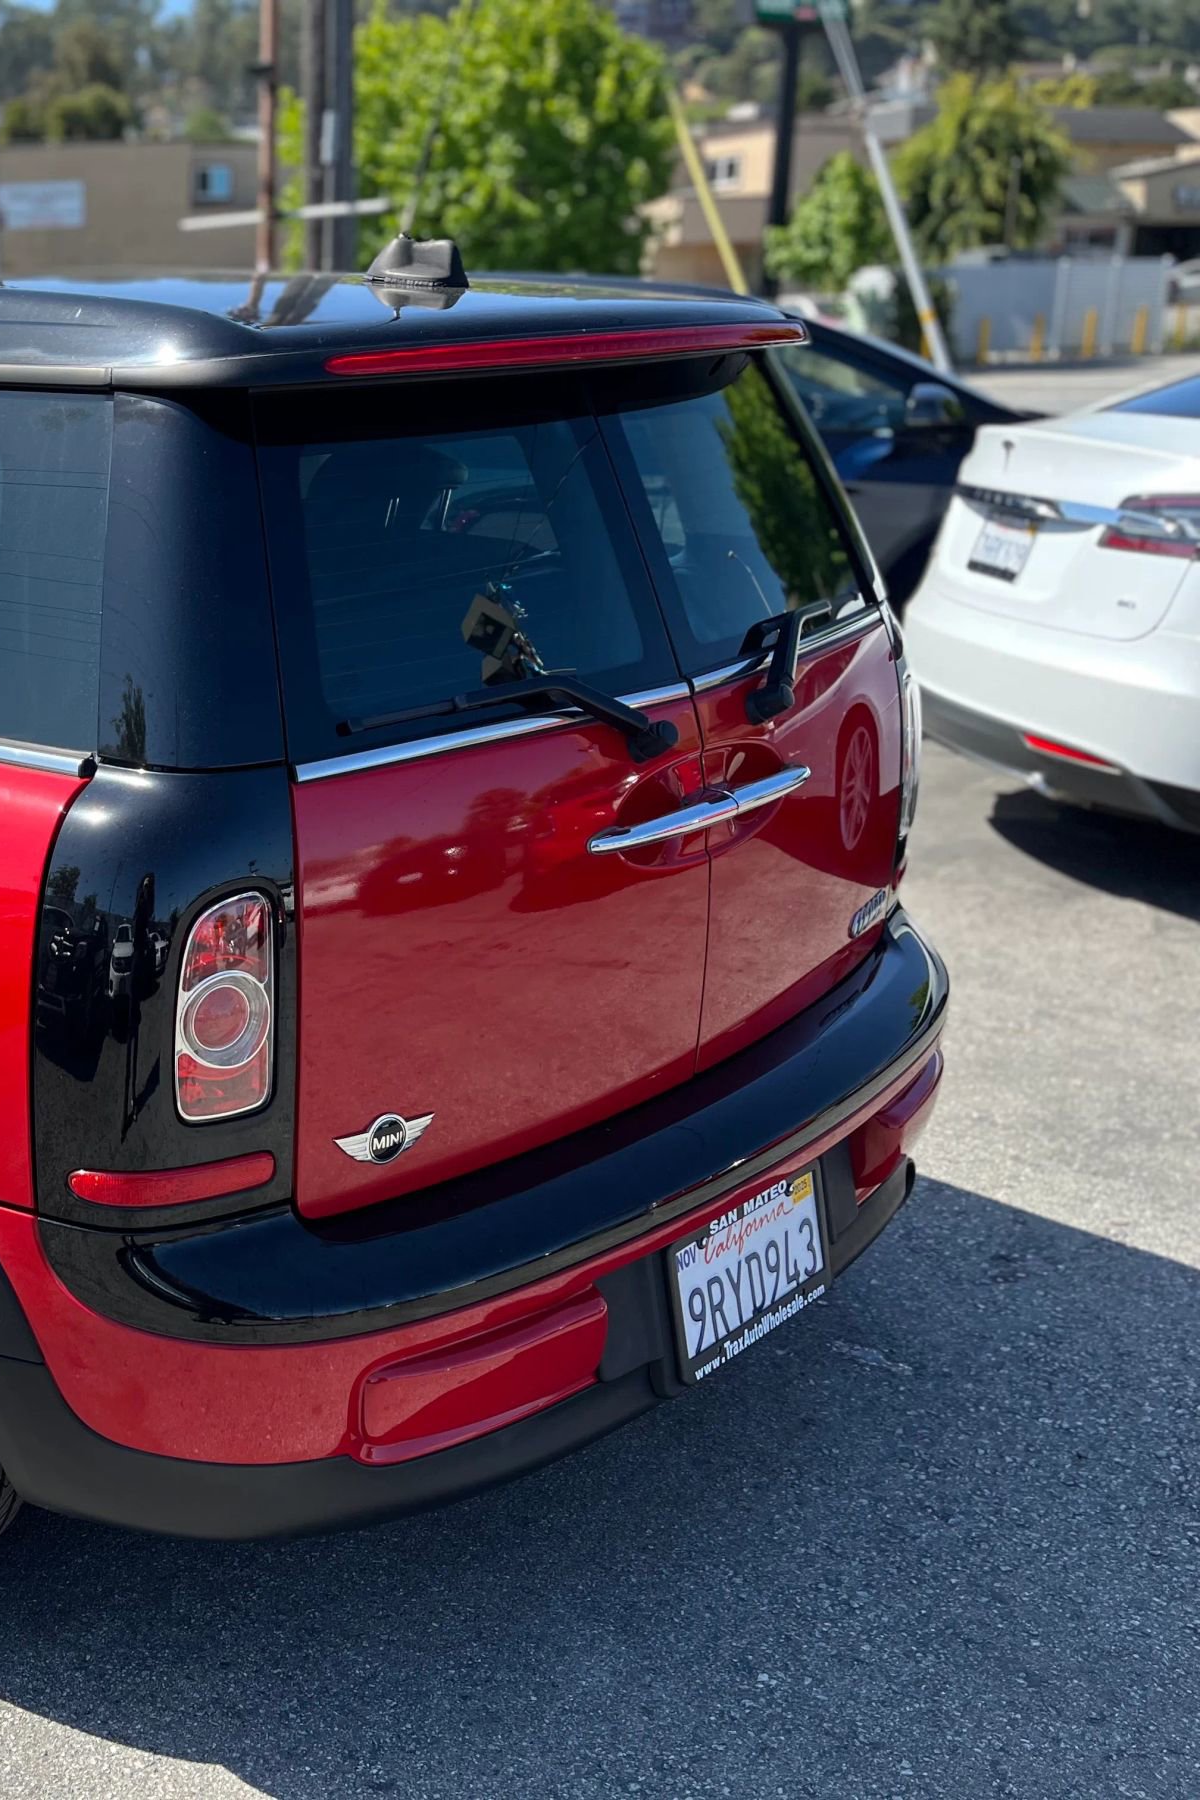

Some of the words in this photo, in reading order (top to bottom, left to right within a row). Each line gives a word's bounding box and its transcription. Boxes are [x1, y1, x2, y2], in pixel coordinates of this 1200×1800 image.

[373, 1131, 403, 1151] MINI
[704, 1200, 794, 1265] California
[710, 1209, 737, 1235] SAN
[743, 1179, 787, 1216] MATEO
[676, 1241, 697, 1273] NOV
[688, 1217, 817, 1356] 9RYD943
[694, 1283, 825, 1381] www.TraxAutoWholesale.com
